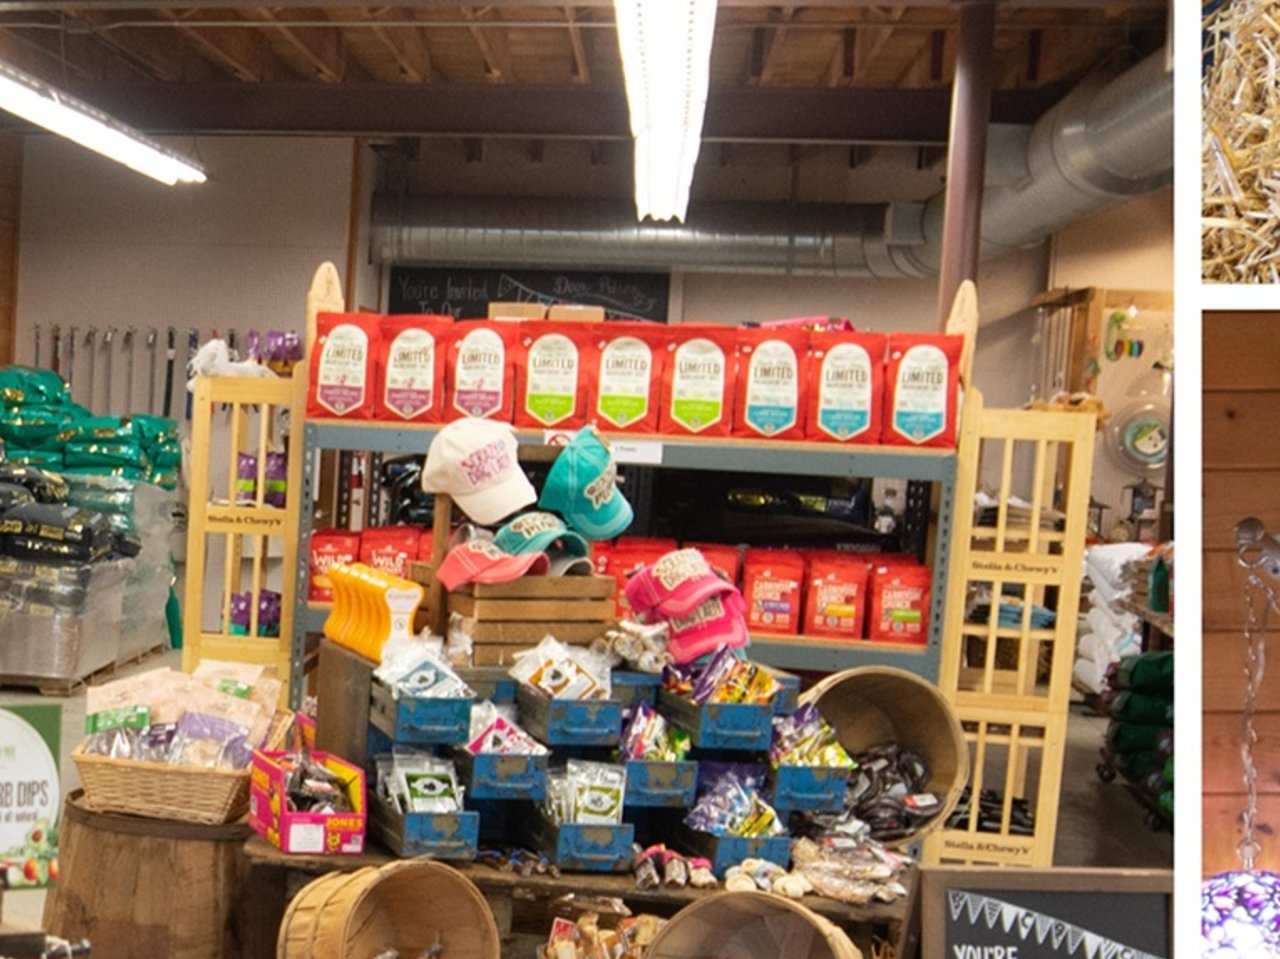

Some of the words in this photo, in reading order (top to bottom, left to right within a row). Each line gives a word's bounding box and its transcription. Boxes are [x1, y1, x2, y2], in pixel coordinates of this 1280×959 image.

[325, 347, 363, 362] LIMITED
[393, 348, 432, 363] LIMITED
[461, 351, 501, 366] LIMITED
[532, 356, 575, 370] LIMITED
[604, 357, 648, 371] LIMITED
[678, 361, 721, 375] LIMITED
[753, 366, 794, 380] LIMITED
[825, 368, 868, 383] LIMITED
[901, 370, 944, 385] LIMITED
[207, 515, 234, 524] Stella
[235, 515, 242, 524] &
[243, 515, 282, 527] Chewy's
[372, 550, 404, 568] WILD
[971, 561, 1003, 571] Stella
[1004, 562, 1012, 571] &
[1014, 562, 1058, 575] Chewy's
[16, 779, 50, 807] DIPS
[326, 817, 363, 829] JONES
[944, 840, 975, 850] Stella
[985, 842, 1030, 855] Chewy's
